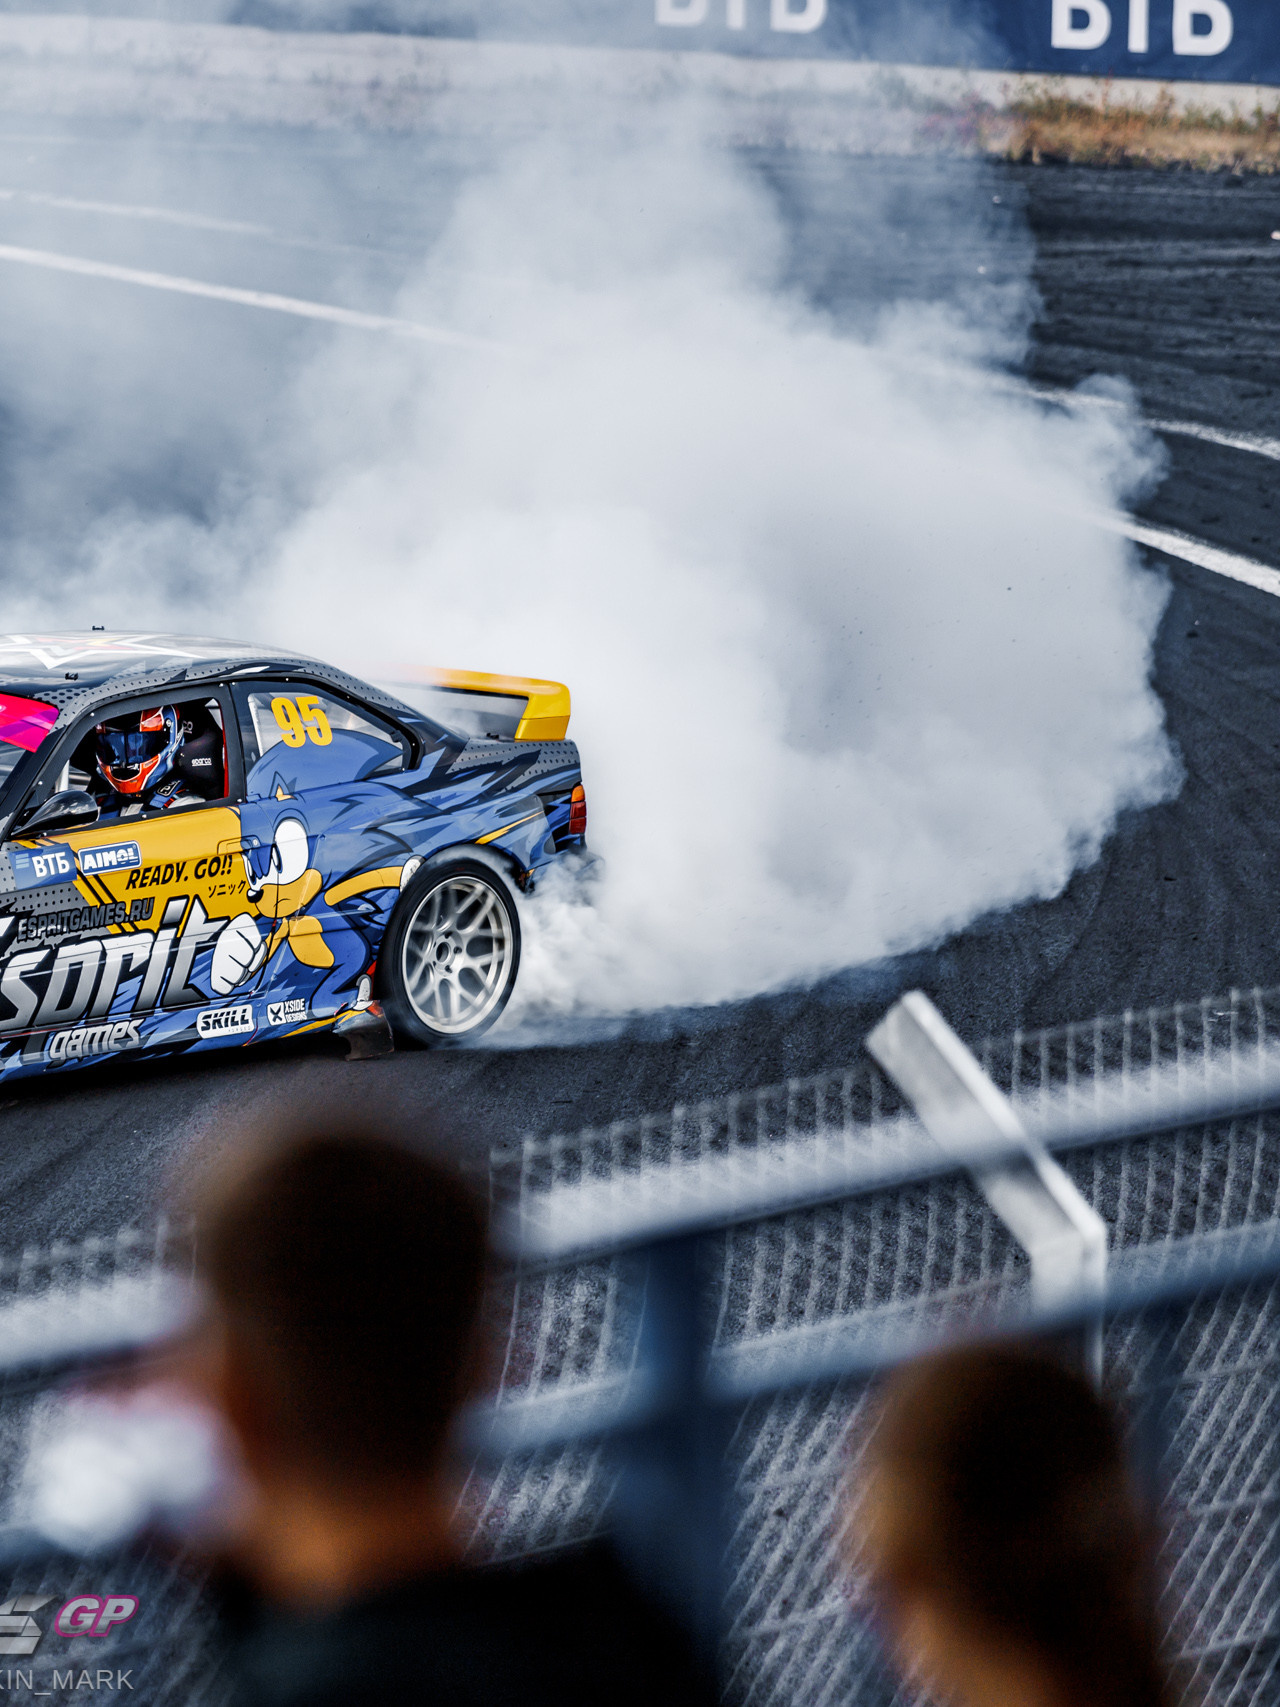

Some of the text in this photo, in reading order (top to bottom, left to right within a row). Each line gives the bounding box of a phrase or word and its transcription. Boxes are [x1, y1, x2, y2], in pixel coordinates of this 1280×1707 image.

[271, 696, 333, 748] 95
[32, 852, 70, 878] ВТБ
[83, 846, 139, 870] AIMOL
[125, 855, 233, 890] READY. GO!!
[208, 880, 246, 898] ソニック
[19, 897, 155, 941] ESPRITGAMES.RU
[284, 998, 306, 1012] XSIDE
[201, 1008, 250, 1031] SKILL
[48, 1018, 144, 1067] games
